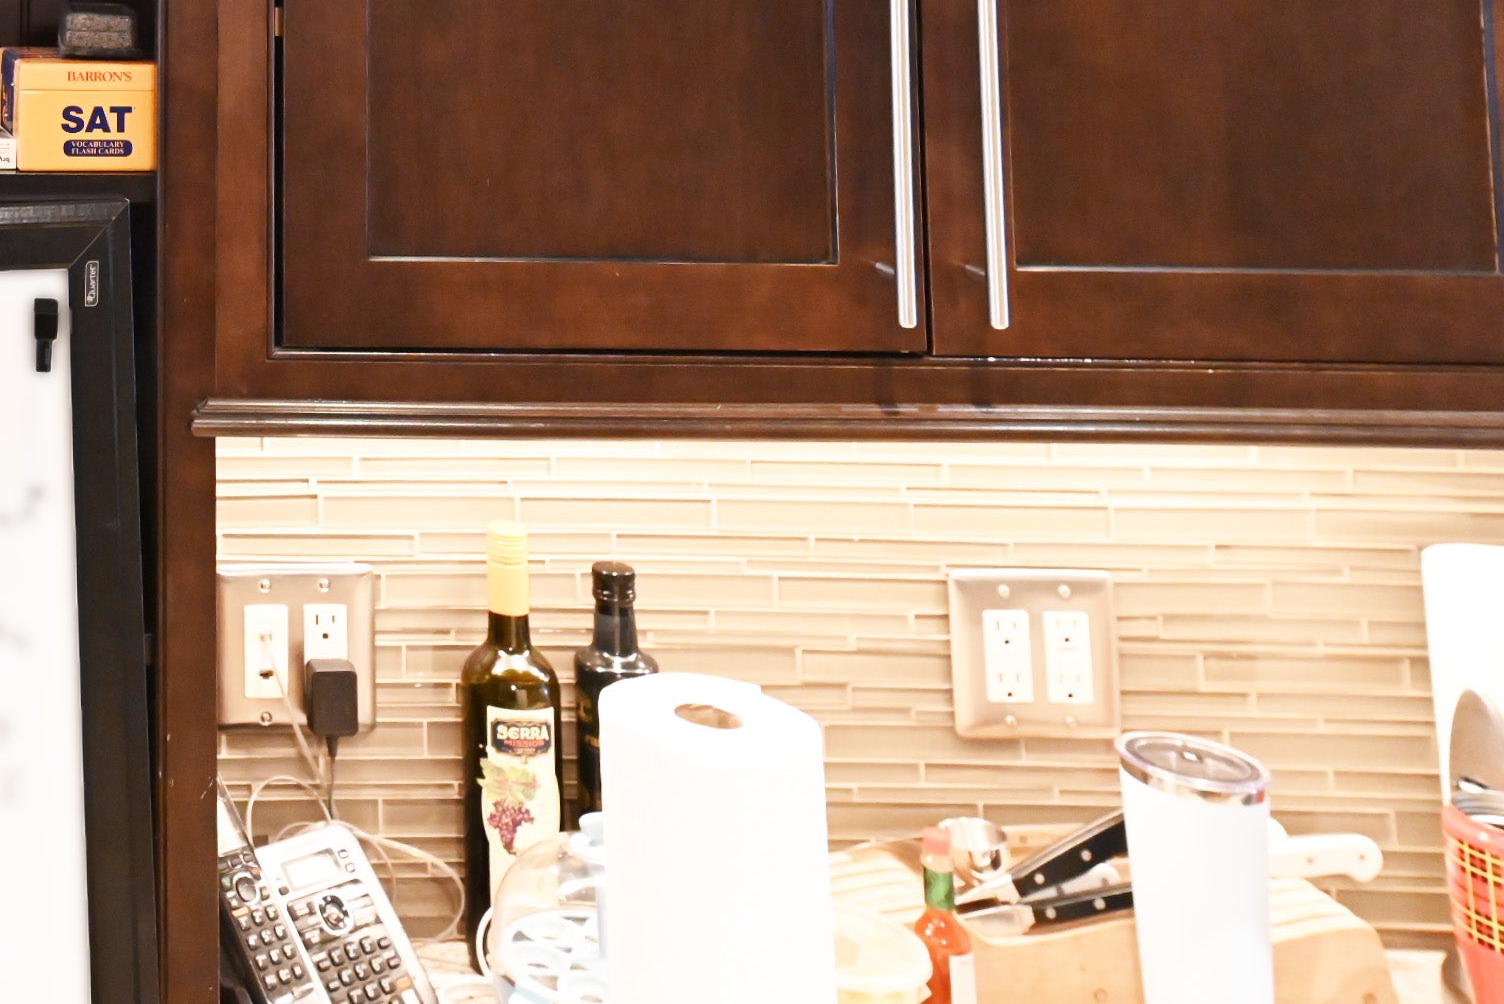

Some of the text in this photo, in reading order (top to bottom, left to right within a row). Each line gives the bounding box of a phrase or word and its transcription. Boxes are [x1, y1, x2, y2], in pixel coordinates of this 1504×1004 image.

[67, 71, 133, 82] BARRON'S
[61, 105, 133, 134] SAT
[496, 724, 550, 741] SERRA
